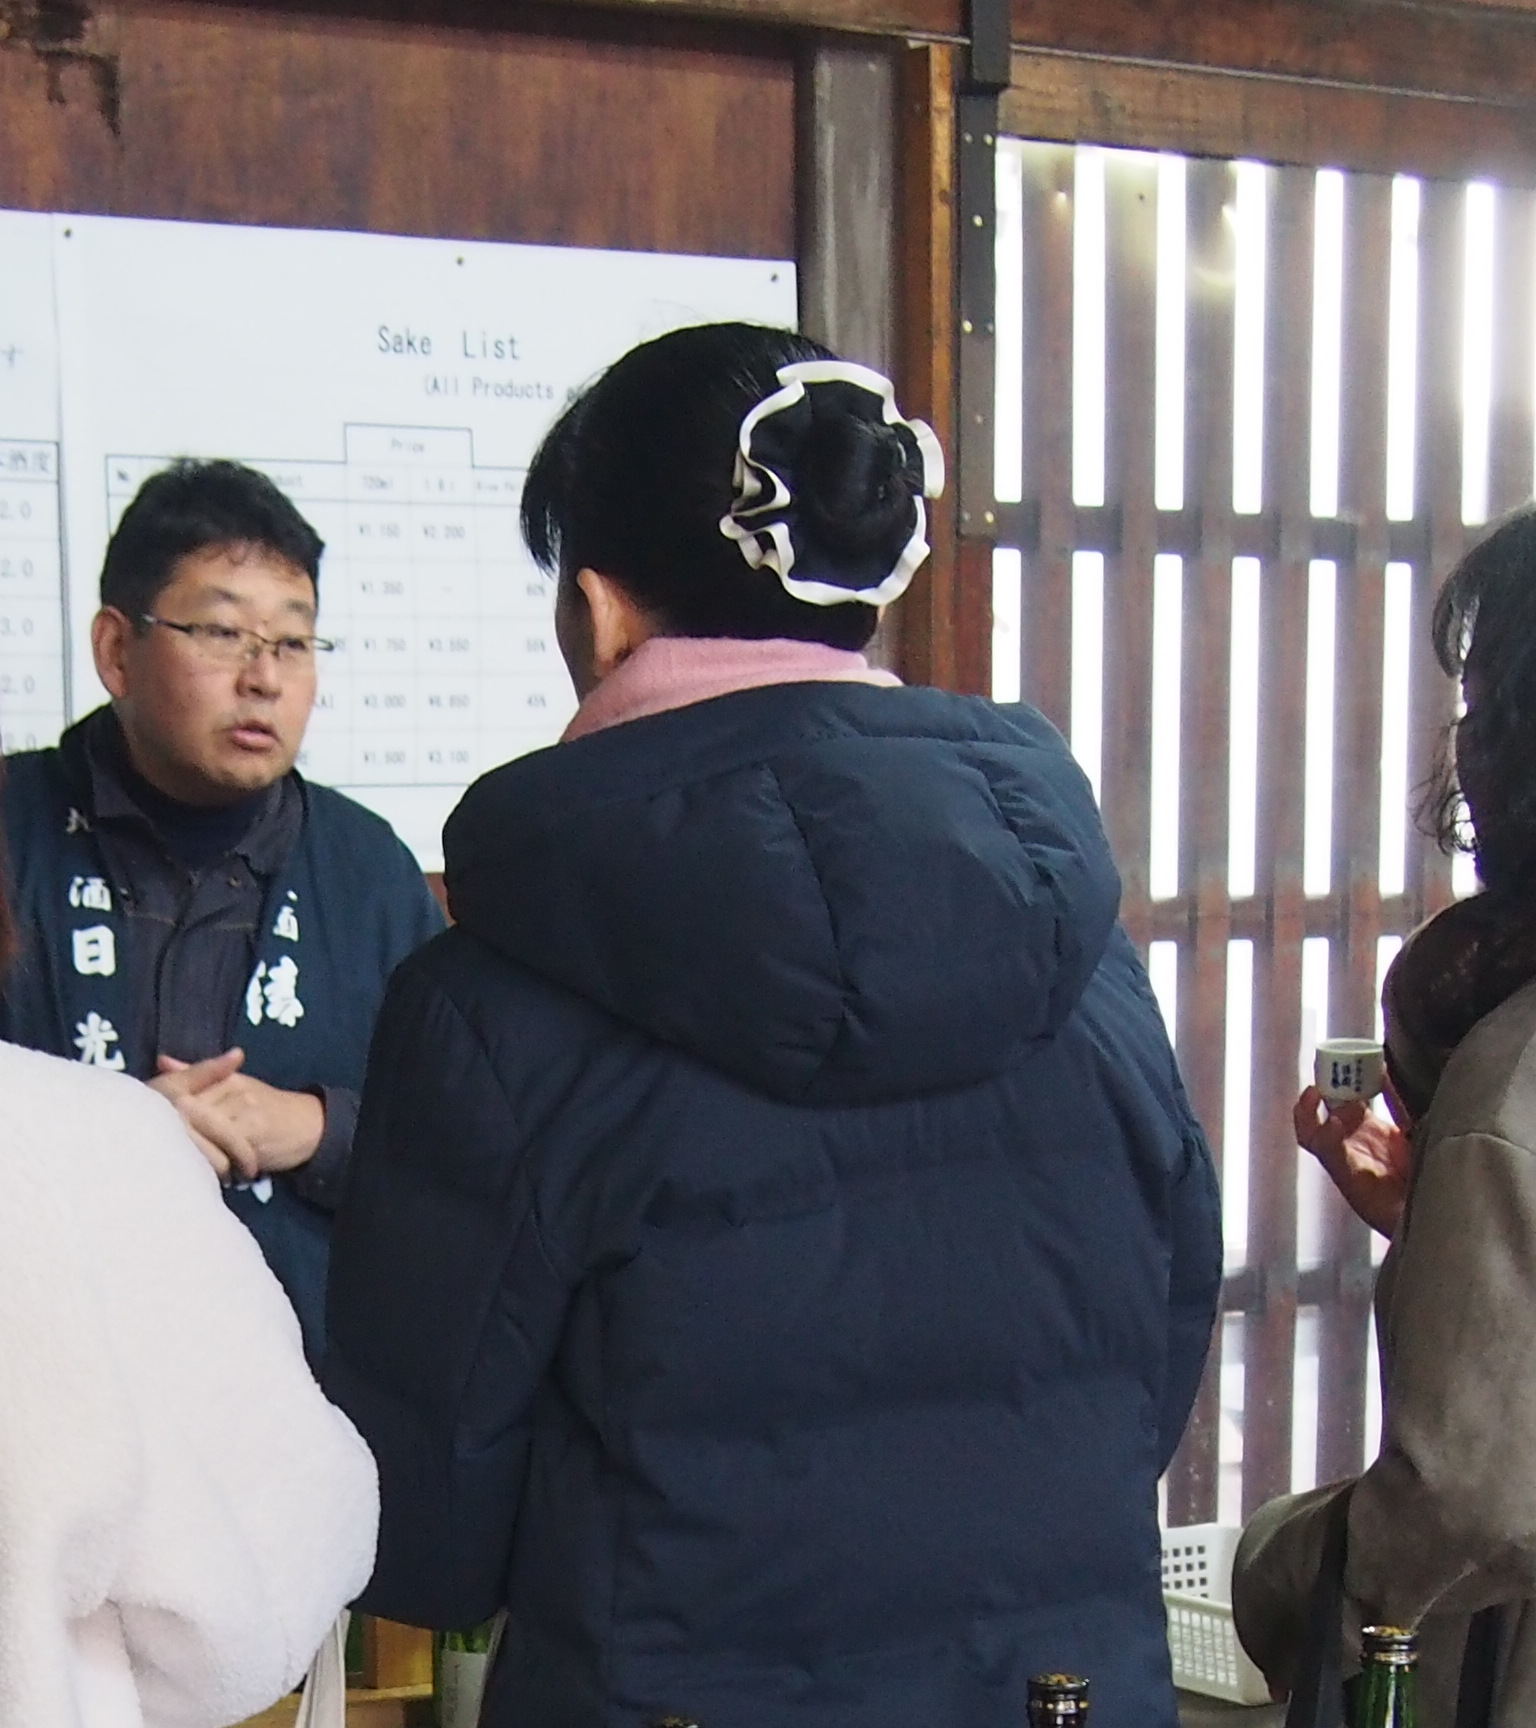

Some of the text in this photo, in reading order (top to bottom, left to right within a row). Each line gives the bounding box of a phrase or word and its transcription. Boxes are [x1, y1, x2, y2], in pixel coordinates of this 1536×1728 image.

[378, 325, 520, 360] Sake List
[425, 376, 459, 396] (All
[472, 377, 554, 400] Products
[391, 437, 425, 452] Price
